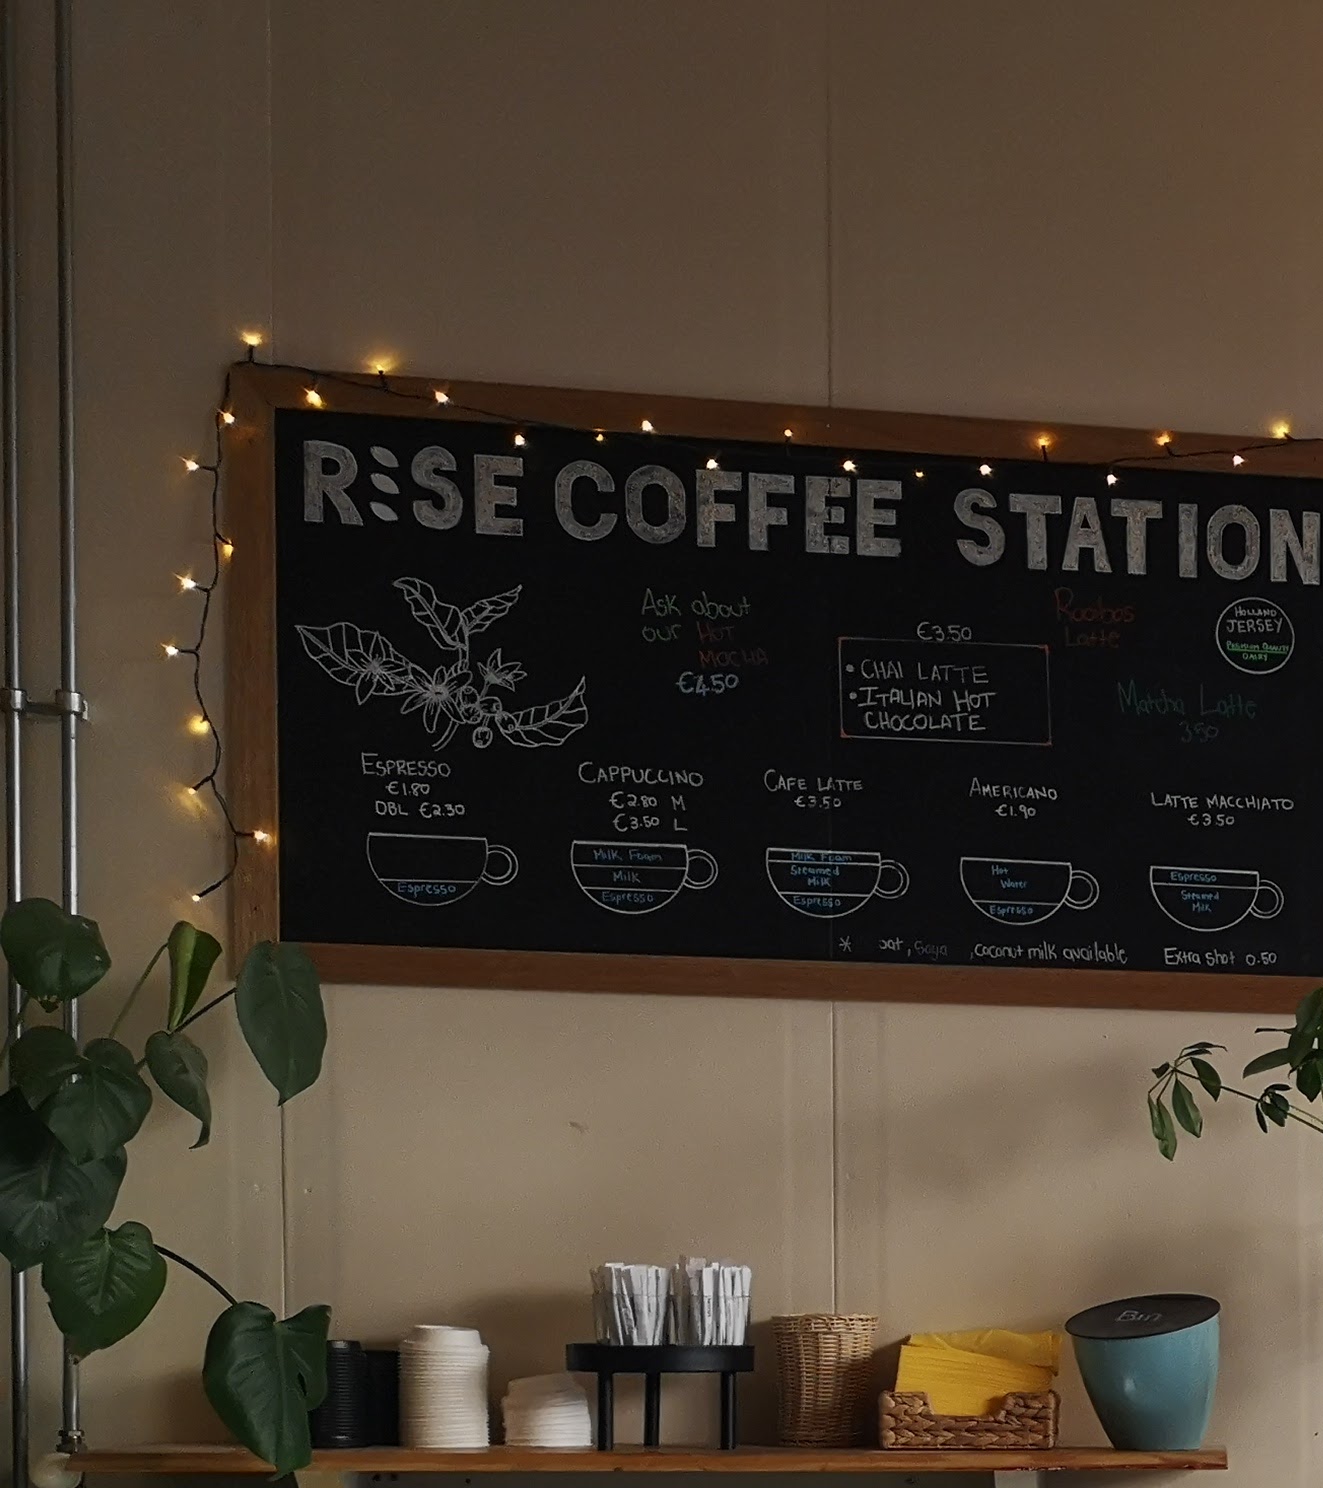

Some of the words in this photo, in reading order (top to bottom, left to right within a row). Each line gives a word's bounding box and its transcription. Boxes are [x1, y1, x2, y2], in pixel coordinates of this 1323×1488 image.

[554, 458, 903, 558] COFFEE
[953, 486, 1323, 586] STATION
[641, 587, 682, 618] Ask
[690, 589, 753, 620] about
[641, 623, 682, 644] our
[1225, 617, 1284, 634] JERSEY
[859, 659, 905, 680] CHAI
[917, 661, 990, 685] LATTE
[858, 686, 943, 709] ITALIAN
[954, 688, 997, 712] HOT
[863, 711, 987, 732] CHOCOLATE
[361, 751, 452, 778] ESPRESSO
[577, 761, 705, 788] CAPPUCCINO
[816, 776, 865, 792] LATTE
[968, 776, 1059, 801] AMERICANO
[375, 800, 409, 817] DBL
[418, 802, 467, 820] €2.30
[1150, 791, 1200, 810] LATTE
[1206, 794, 1295, 812] MACCHIATO
[1027, 940, 1058, 962] milk
[1062, 941, 1129, 966] available
[1163, 946, 1201, 966] Extra
[1205, 946, 1236, 967] shot
